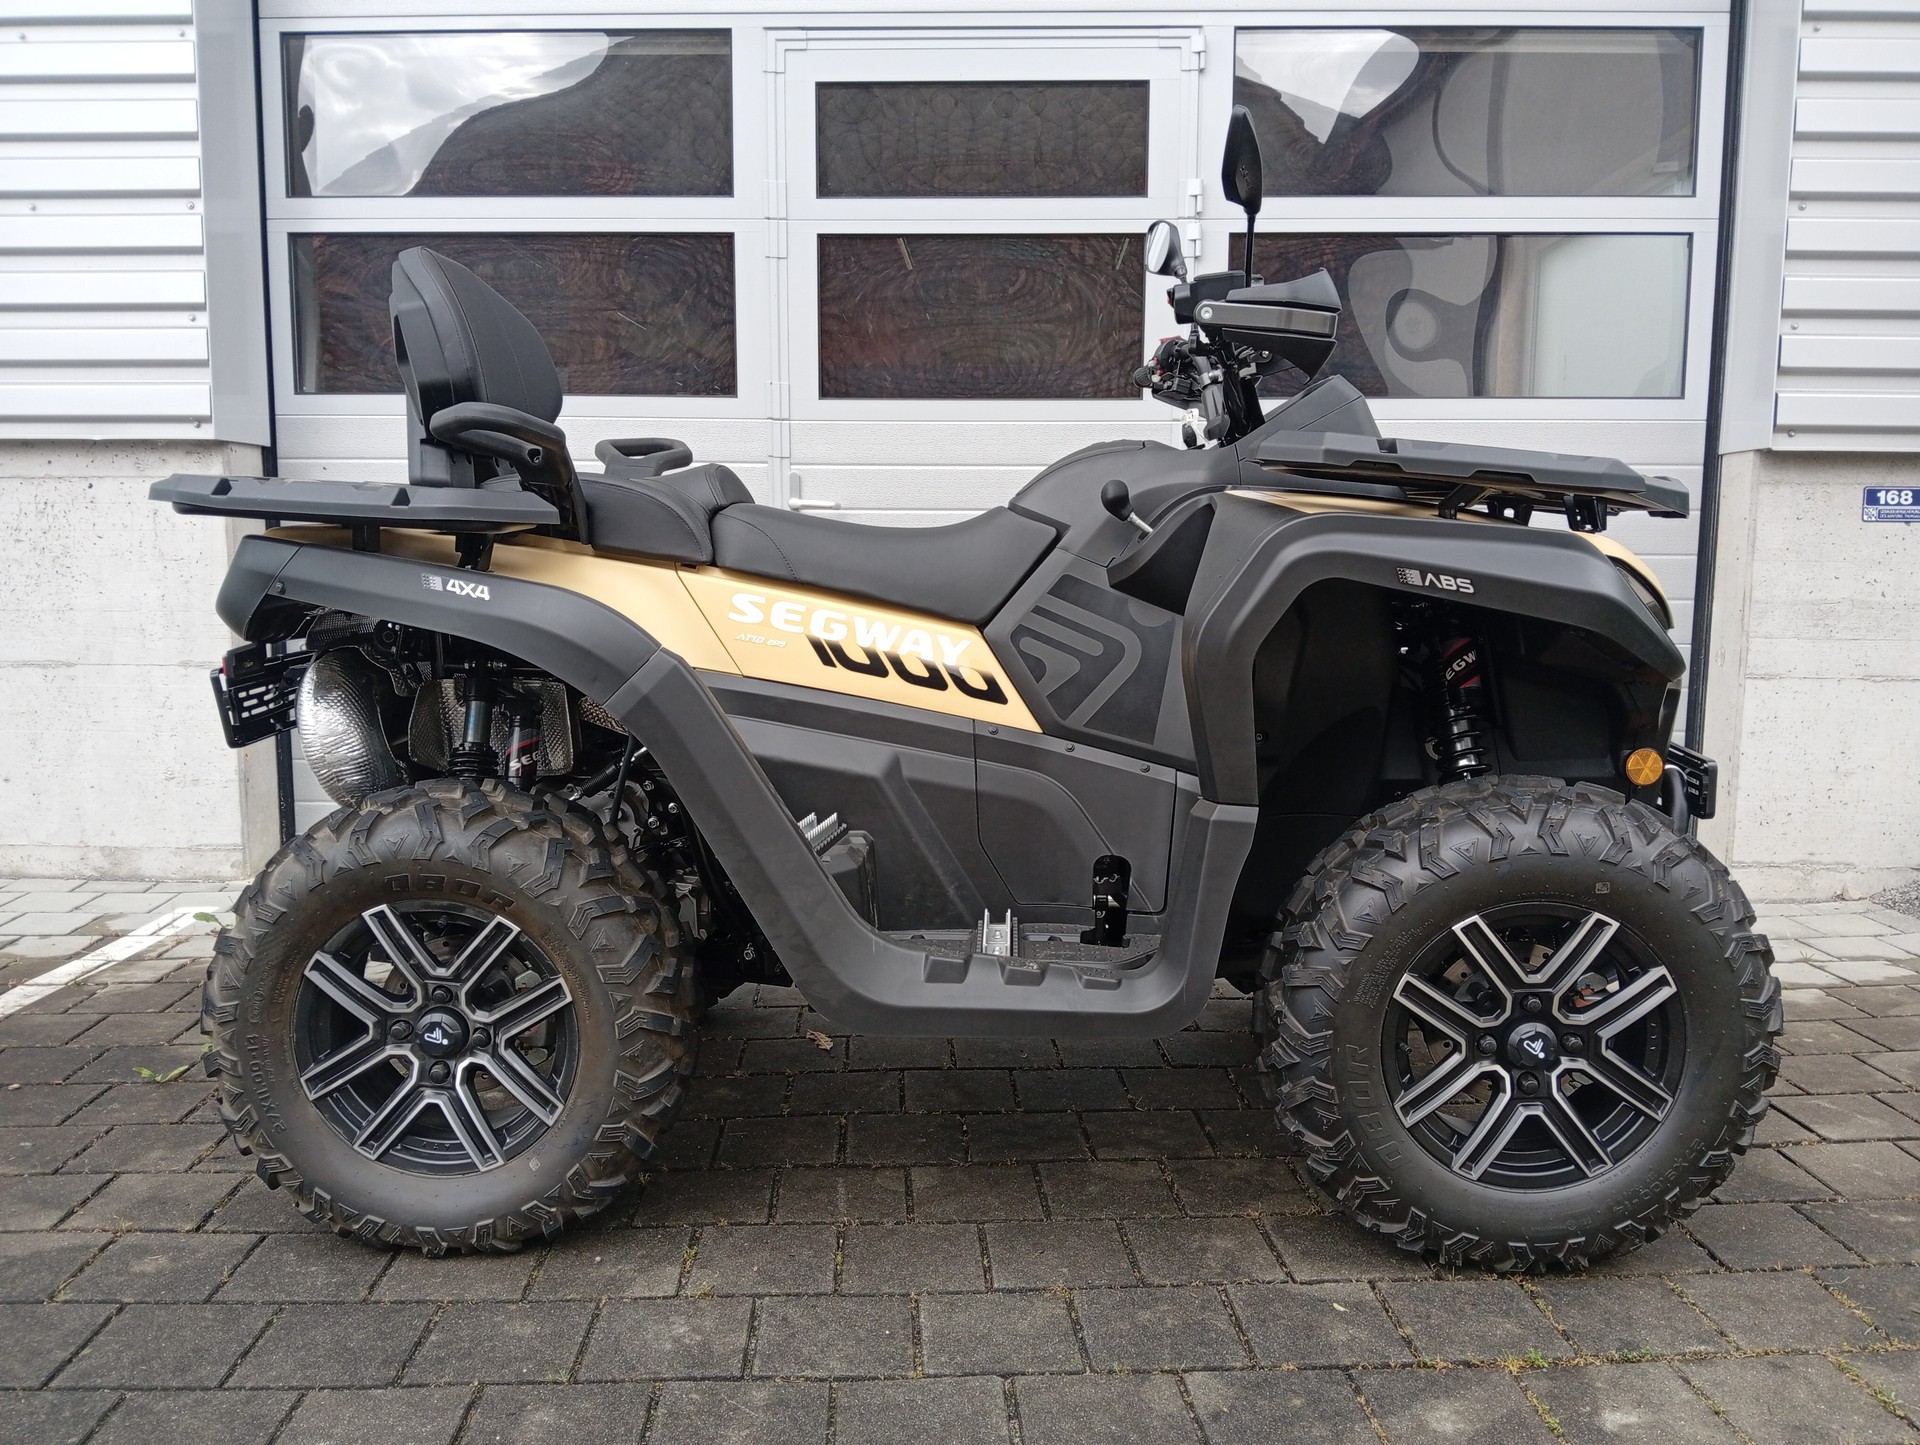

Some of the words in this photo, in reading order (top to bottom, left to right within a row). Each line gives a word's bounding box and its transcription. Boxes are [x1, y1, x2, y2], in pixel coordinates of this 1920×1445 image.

[1877, 490, 1913, 505] 168
[446, 578, 490, 601] 4X4
[1424, 572, 1475, 594] ABS
[728, 592, 972, 667] SEGWAY
[805, 633, 1009, 705] 1000
[1445, 649, 1477, 684] EGW
